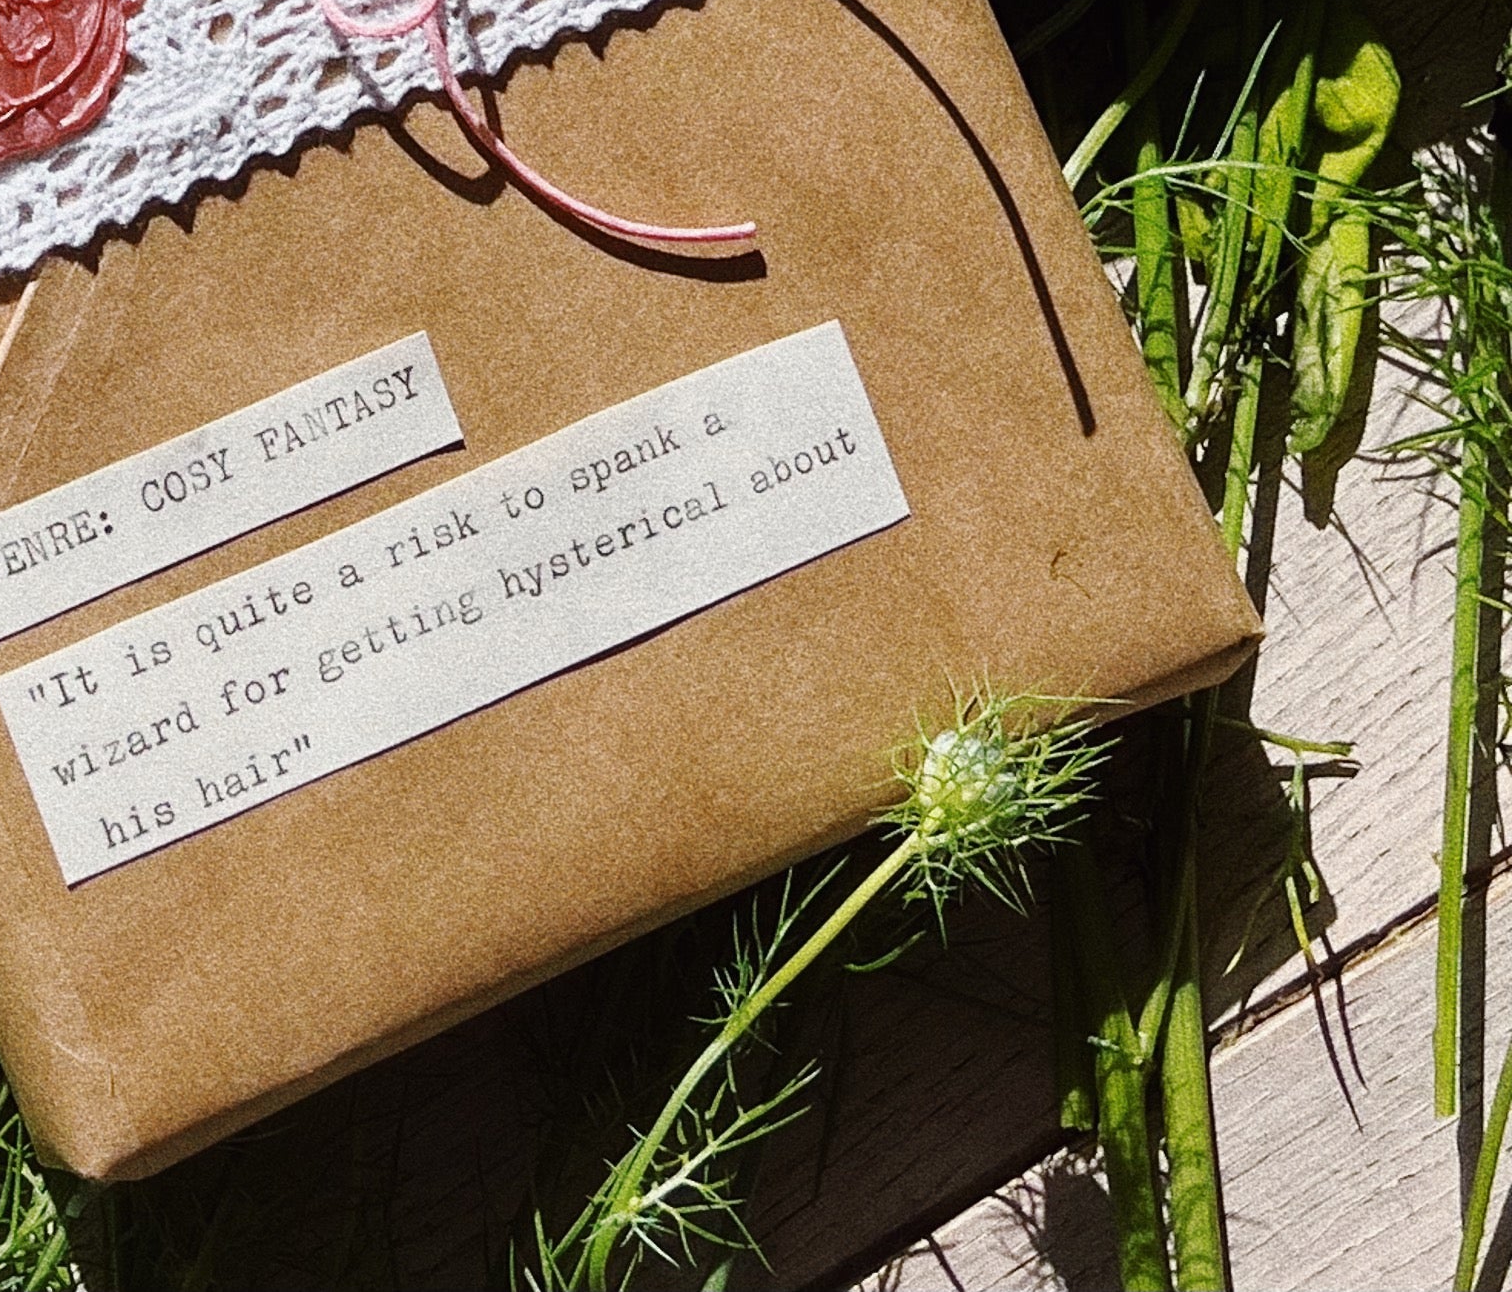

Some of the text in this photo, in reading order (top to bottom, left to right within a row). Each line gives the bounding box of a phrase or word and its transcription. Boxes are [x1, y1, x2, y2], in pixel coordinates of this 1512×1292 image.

[141, 448, 235, 514] COSY
[254, 365, 421, 462] FANTASY
[27, 411, 728, 710] "It is quite a risk to spank a
[51, 426, 857, 788] wizard for getting hysterical about
[99, 733, 312, 849] his hair"
